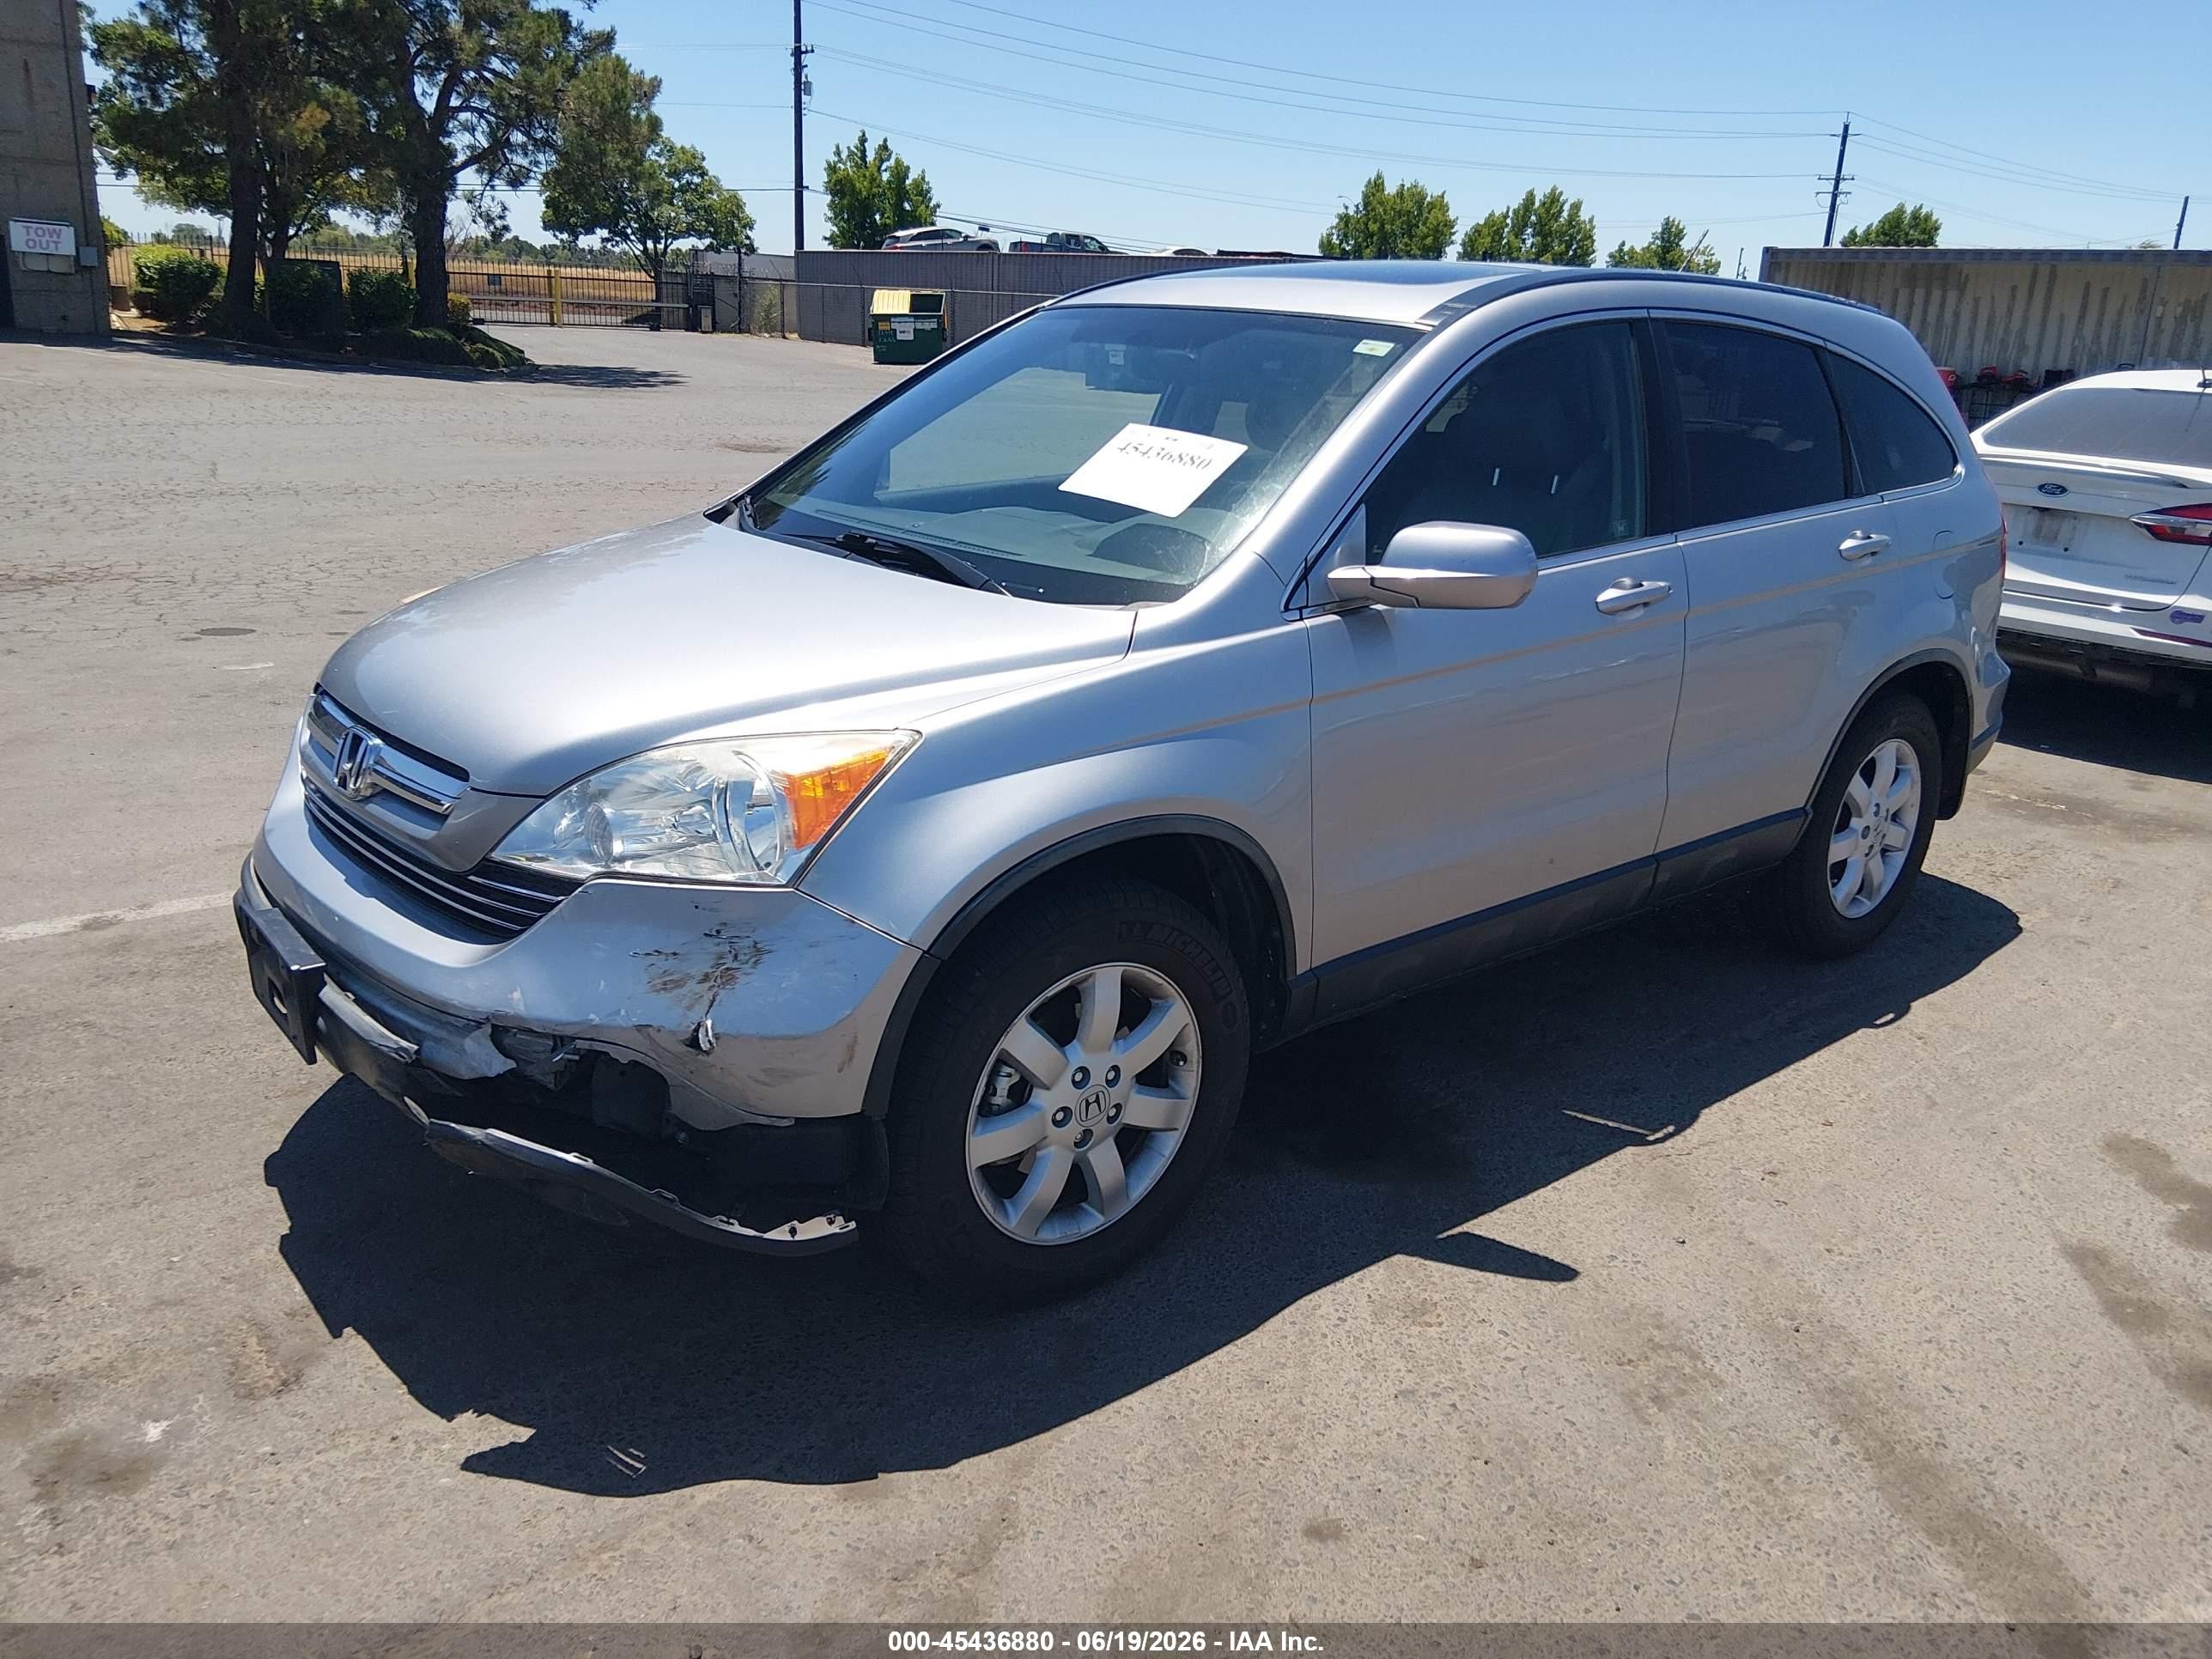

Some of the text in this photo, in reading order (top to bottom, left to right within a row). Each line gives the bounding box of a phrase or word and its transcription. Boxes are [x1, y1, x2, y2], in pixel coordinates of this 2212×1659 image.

[21, 225, 63, 239] TOW
[25, 238, 63, 252] OUT
[1117, 441, 1212, 470] 45436880
[1148, 924, 1233, 999] MICHELIN
